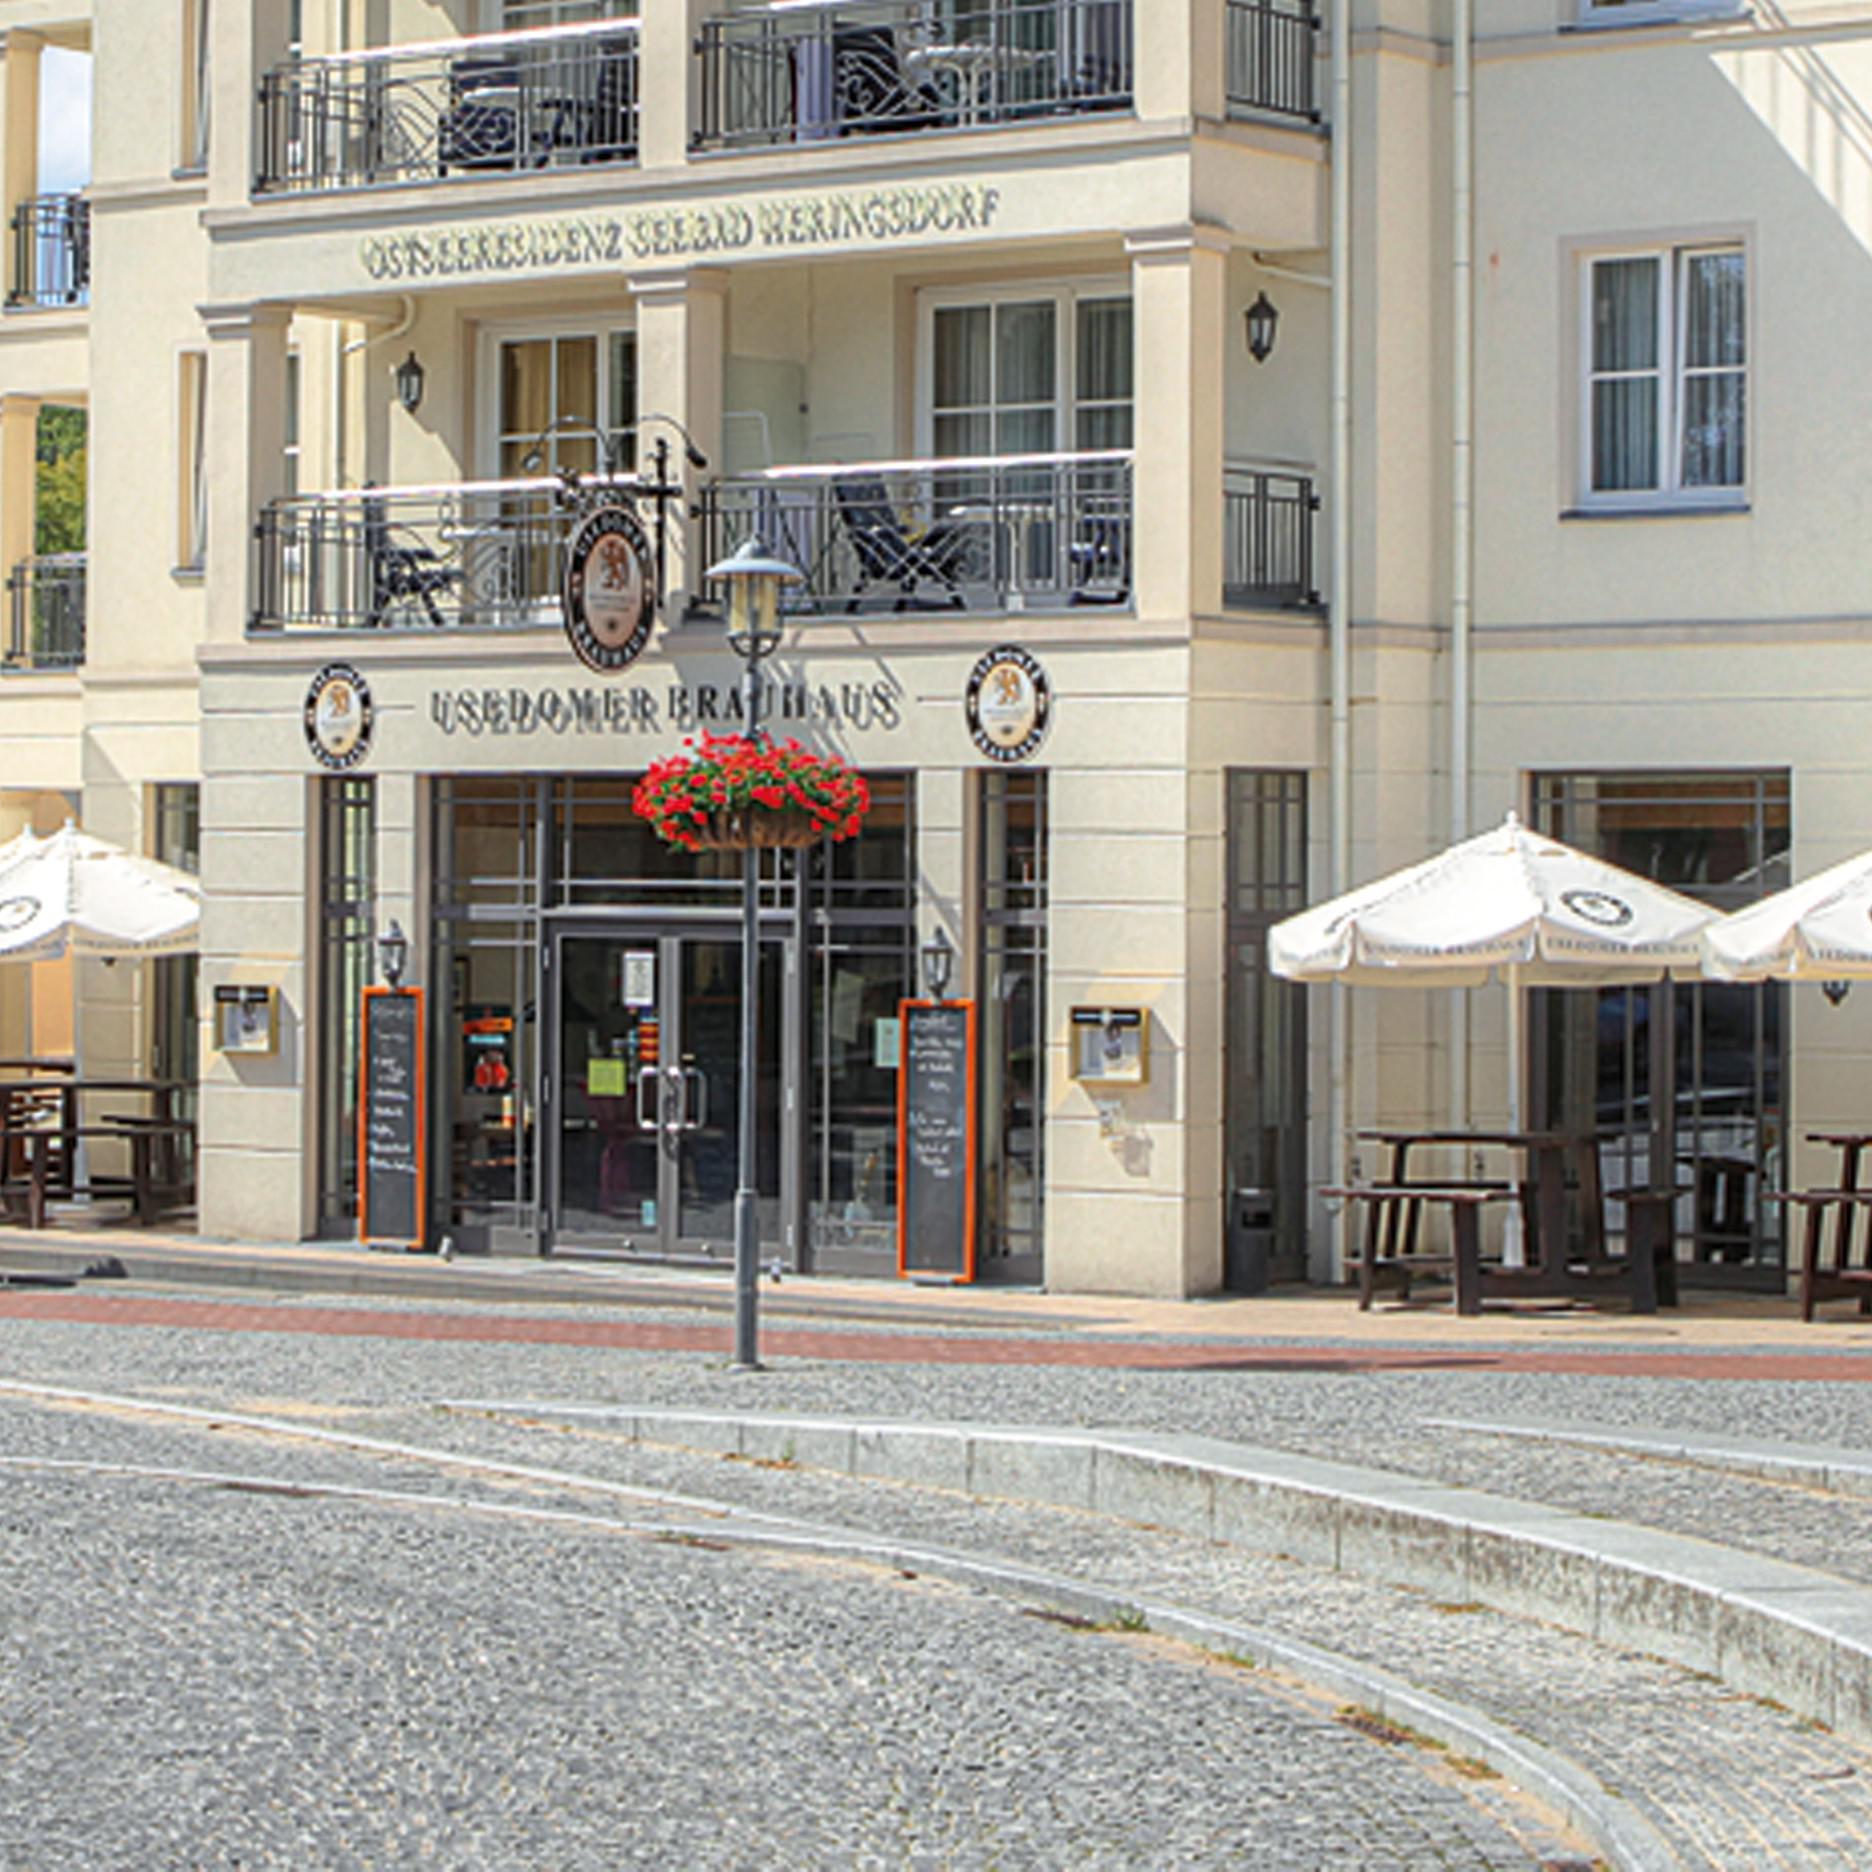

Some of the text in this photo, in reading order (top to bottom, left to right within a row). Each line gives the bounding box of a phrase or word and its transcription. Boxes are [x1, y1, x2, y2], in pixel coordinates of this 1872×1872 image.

[627, 202, 754, 258] SEEBAD
[758, 181, 1000, 246] HERINGSDORF
[431, 680, 898, 730] USEDOMER BRAUHAUS
